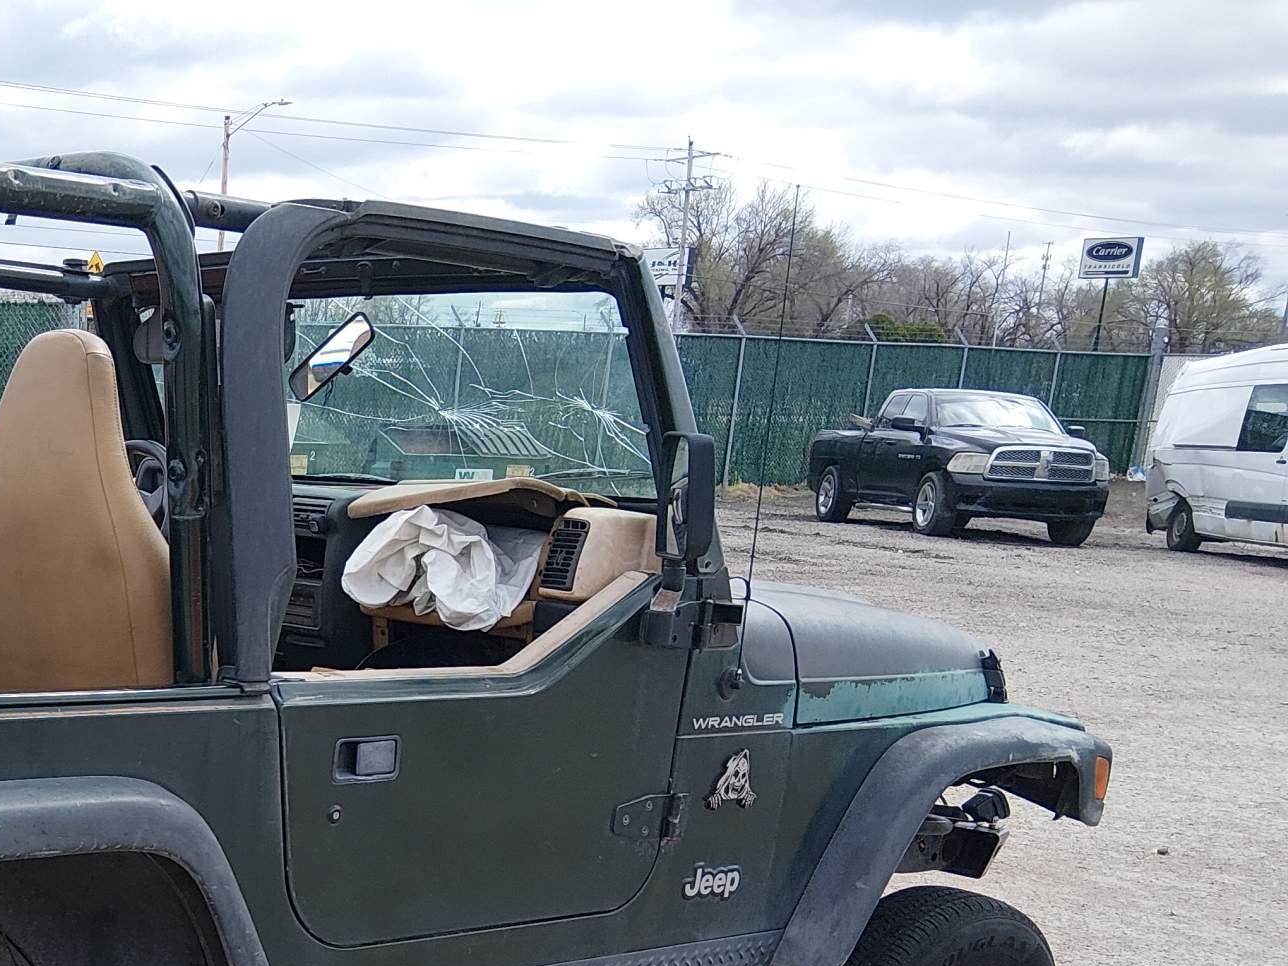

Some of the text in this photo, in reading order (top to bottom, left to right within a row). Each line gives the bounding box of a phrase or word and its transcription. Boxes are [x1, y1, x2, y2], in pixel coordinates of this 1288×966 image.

[1092, 246, 1129, 256] Carrier
[692, 712, 785, 730] WRANGLER
[683, 865, 741, 898] Jeep
